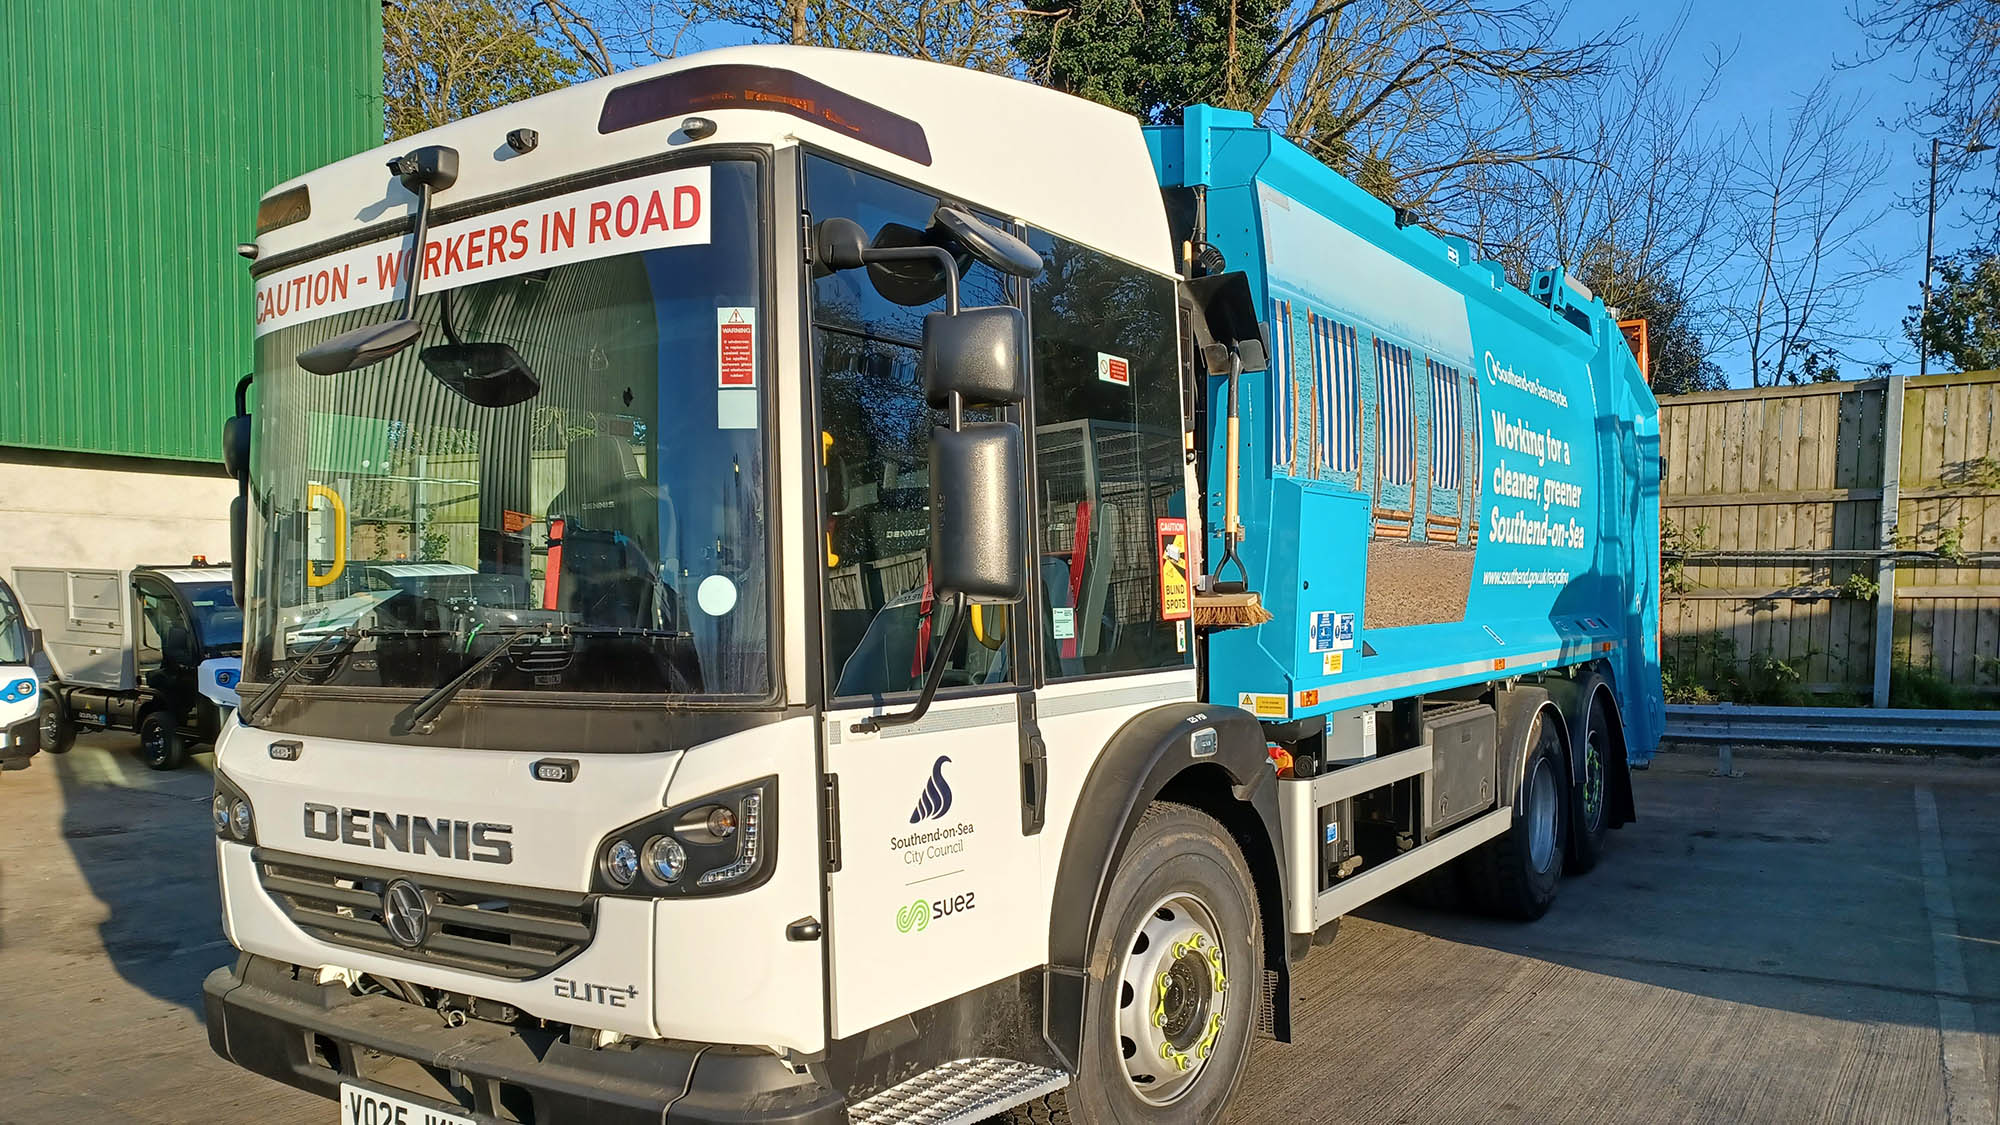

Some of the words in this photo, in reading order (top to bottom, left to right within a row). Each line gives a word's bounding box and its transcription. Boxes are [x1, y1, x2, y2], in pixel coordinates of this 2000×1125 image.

[256, 264, 349, 325] CAUTION
[540, 207, 576, 254] IN
[588, 185, 701, 244] ROAD
[1491, 409, 1545, 467] Working
[1546, 429, 1562, 462] for
[1563, 442, 1571, 466] a
[1493, 458, 1540, 506] cleaner,
[1543, 478, 1582, 511] greener
[886, 528, 926, 538] DENNIS
[1160, 522, 1185, 532] CAUTION
[1489, 505, 1585, 548] Southend-on-Sea
[1166, 584, 1185, 595] BLIND
[1166, 598, 1186, 609] SPOTS
[304, 801, 513, 865] DENNIS
[903, 850, 925, 865] City
[926, 839, 964, 859] Council
[932, 891, 975, 920] suez
[553, 977, 639, 1008] ELITE+
